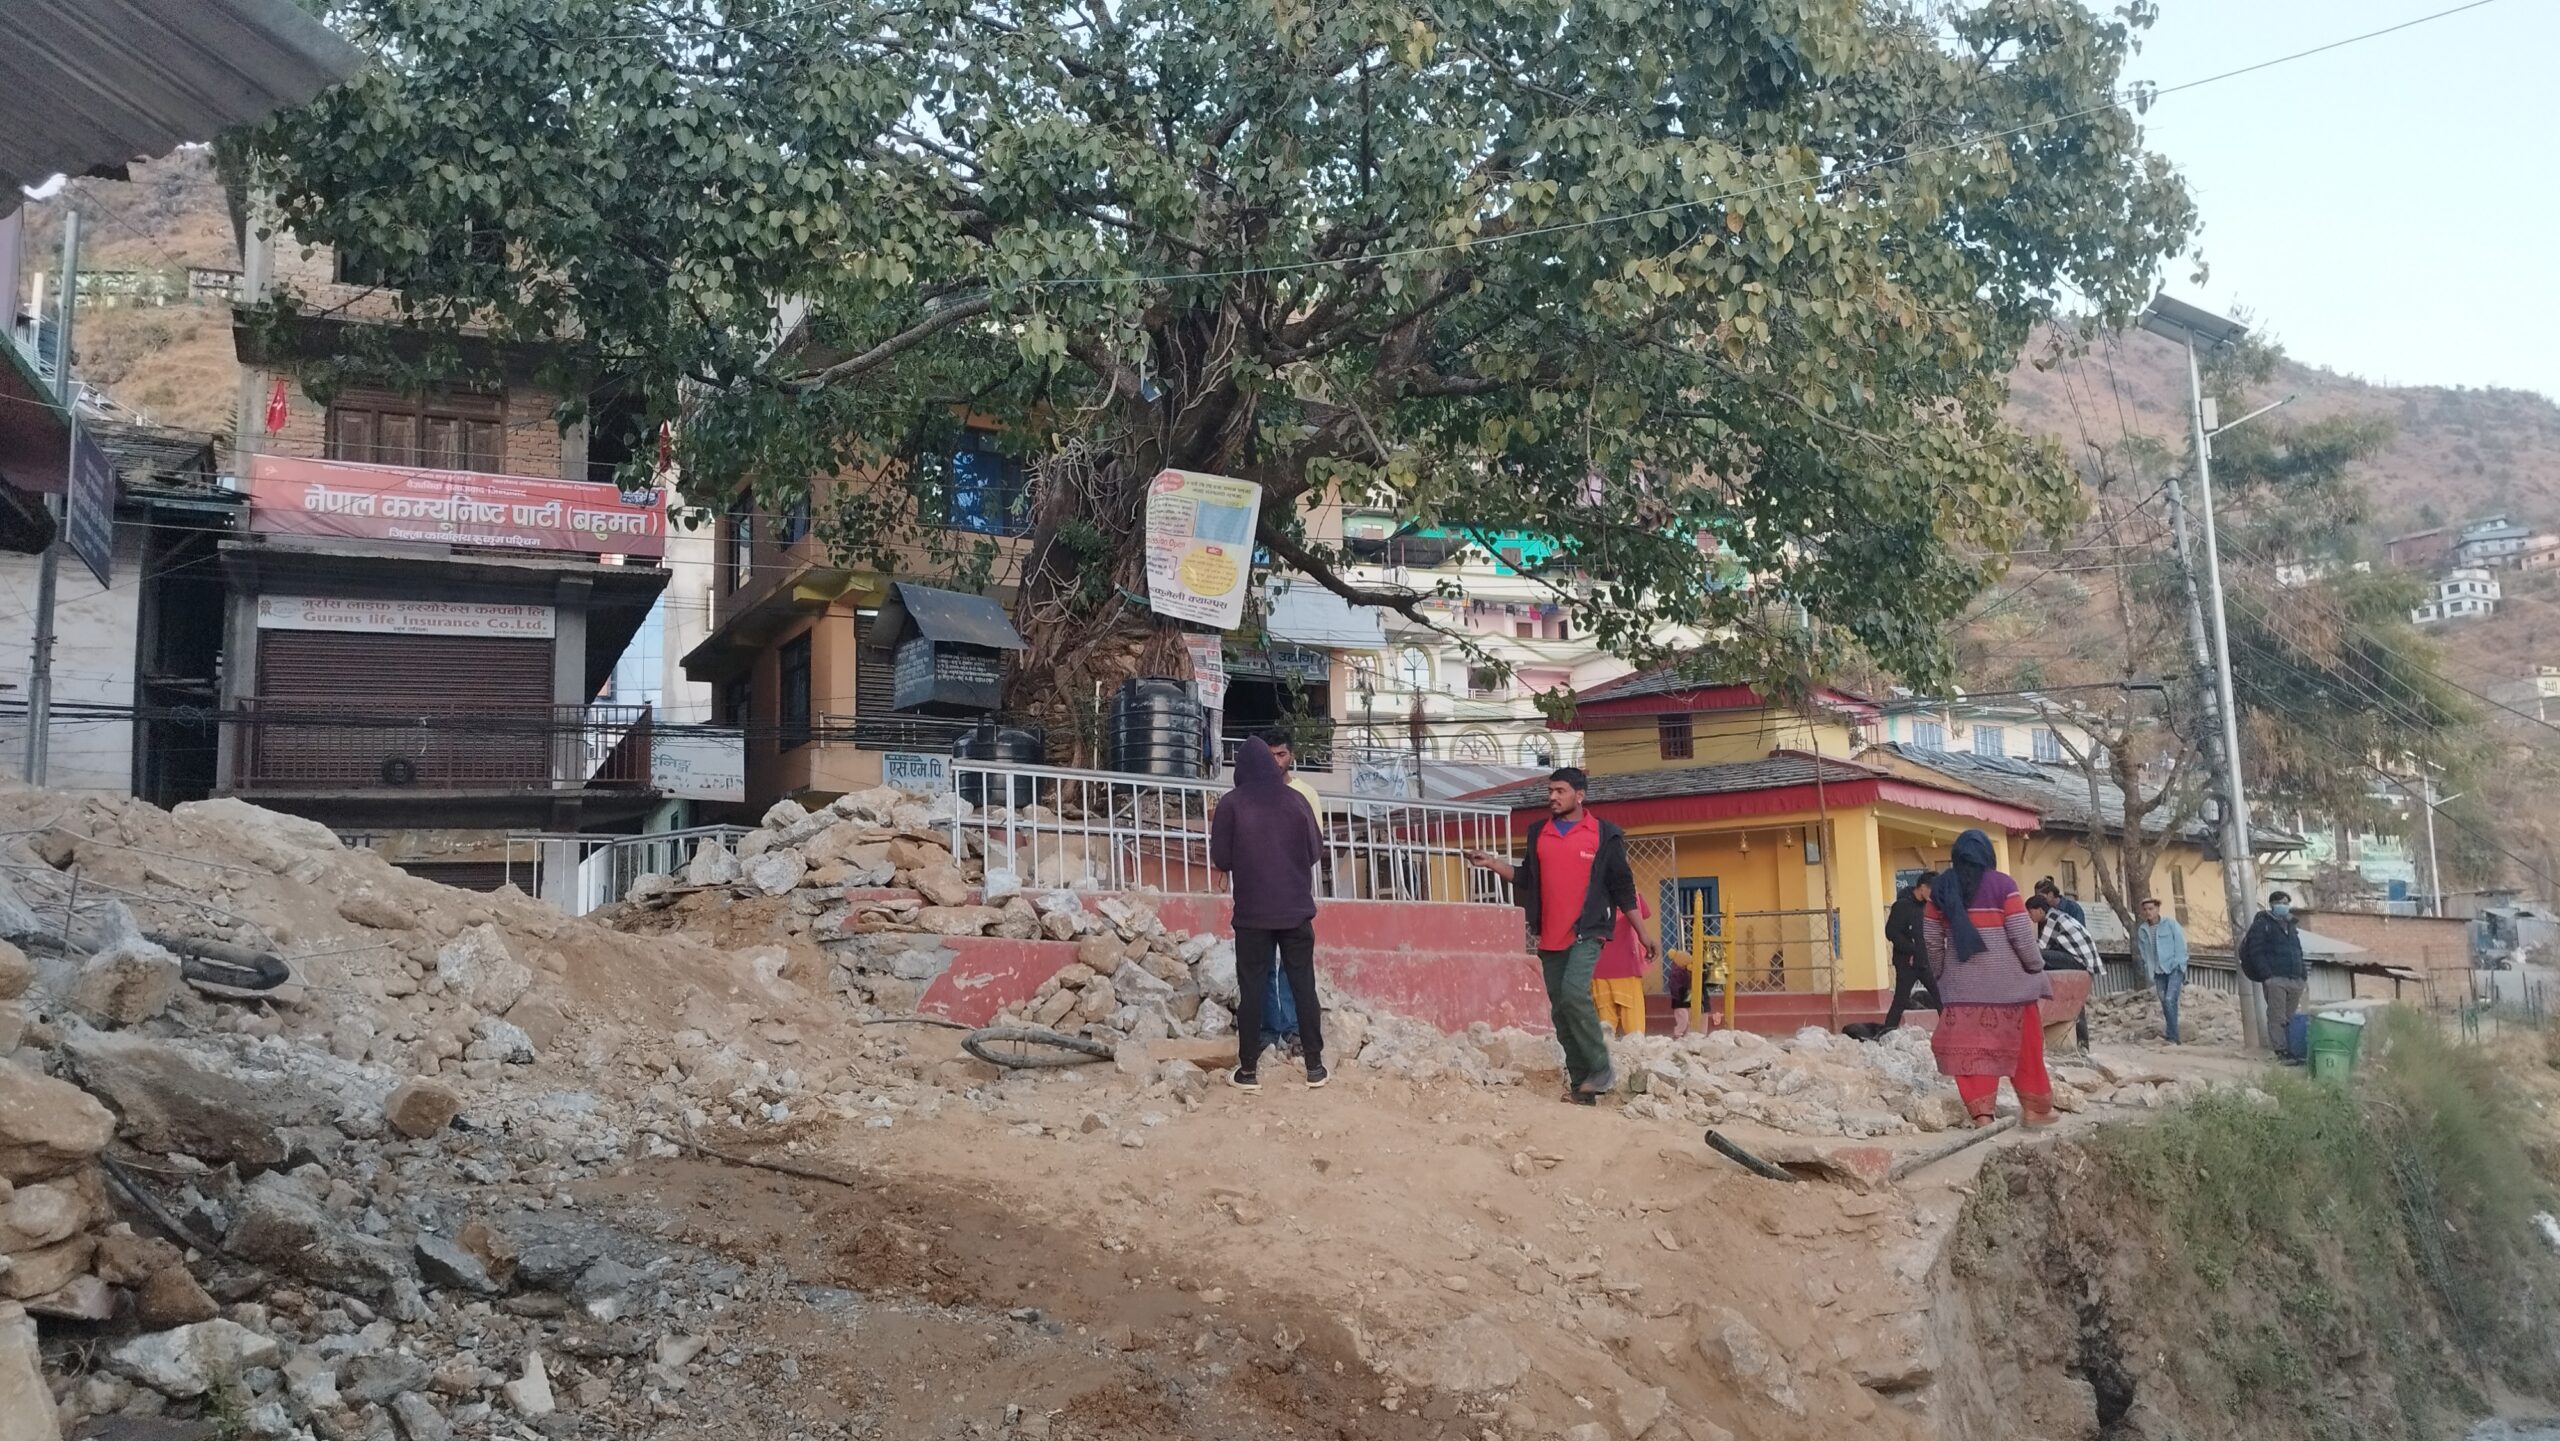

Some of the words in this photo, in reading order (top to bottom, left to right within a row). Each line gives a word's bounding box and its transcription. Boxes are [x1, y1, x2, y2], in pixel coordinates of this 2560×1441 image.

[304, 484, 378, 518] नेपाल
[512, 500, 563, 528] पार्टी
[388, 527, 422, 539] जिल्ला
[424, 529, 471, 543] कार्यालय
[475, 605, 522, 616] कम्पनी
[528, 606, 549, 617] लि.
[303, 612, 361, 624] Gurans
[369, 614, 395, 625] life
[403, 615, 480, 627] Insurance
